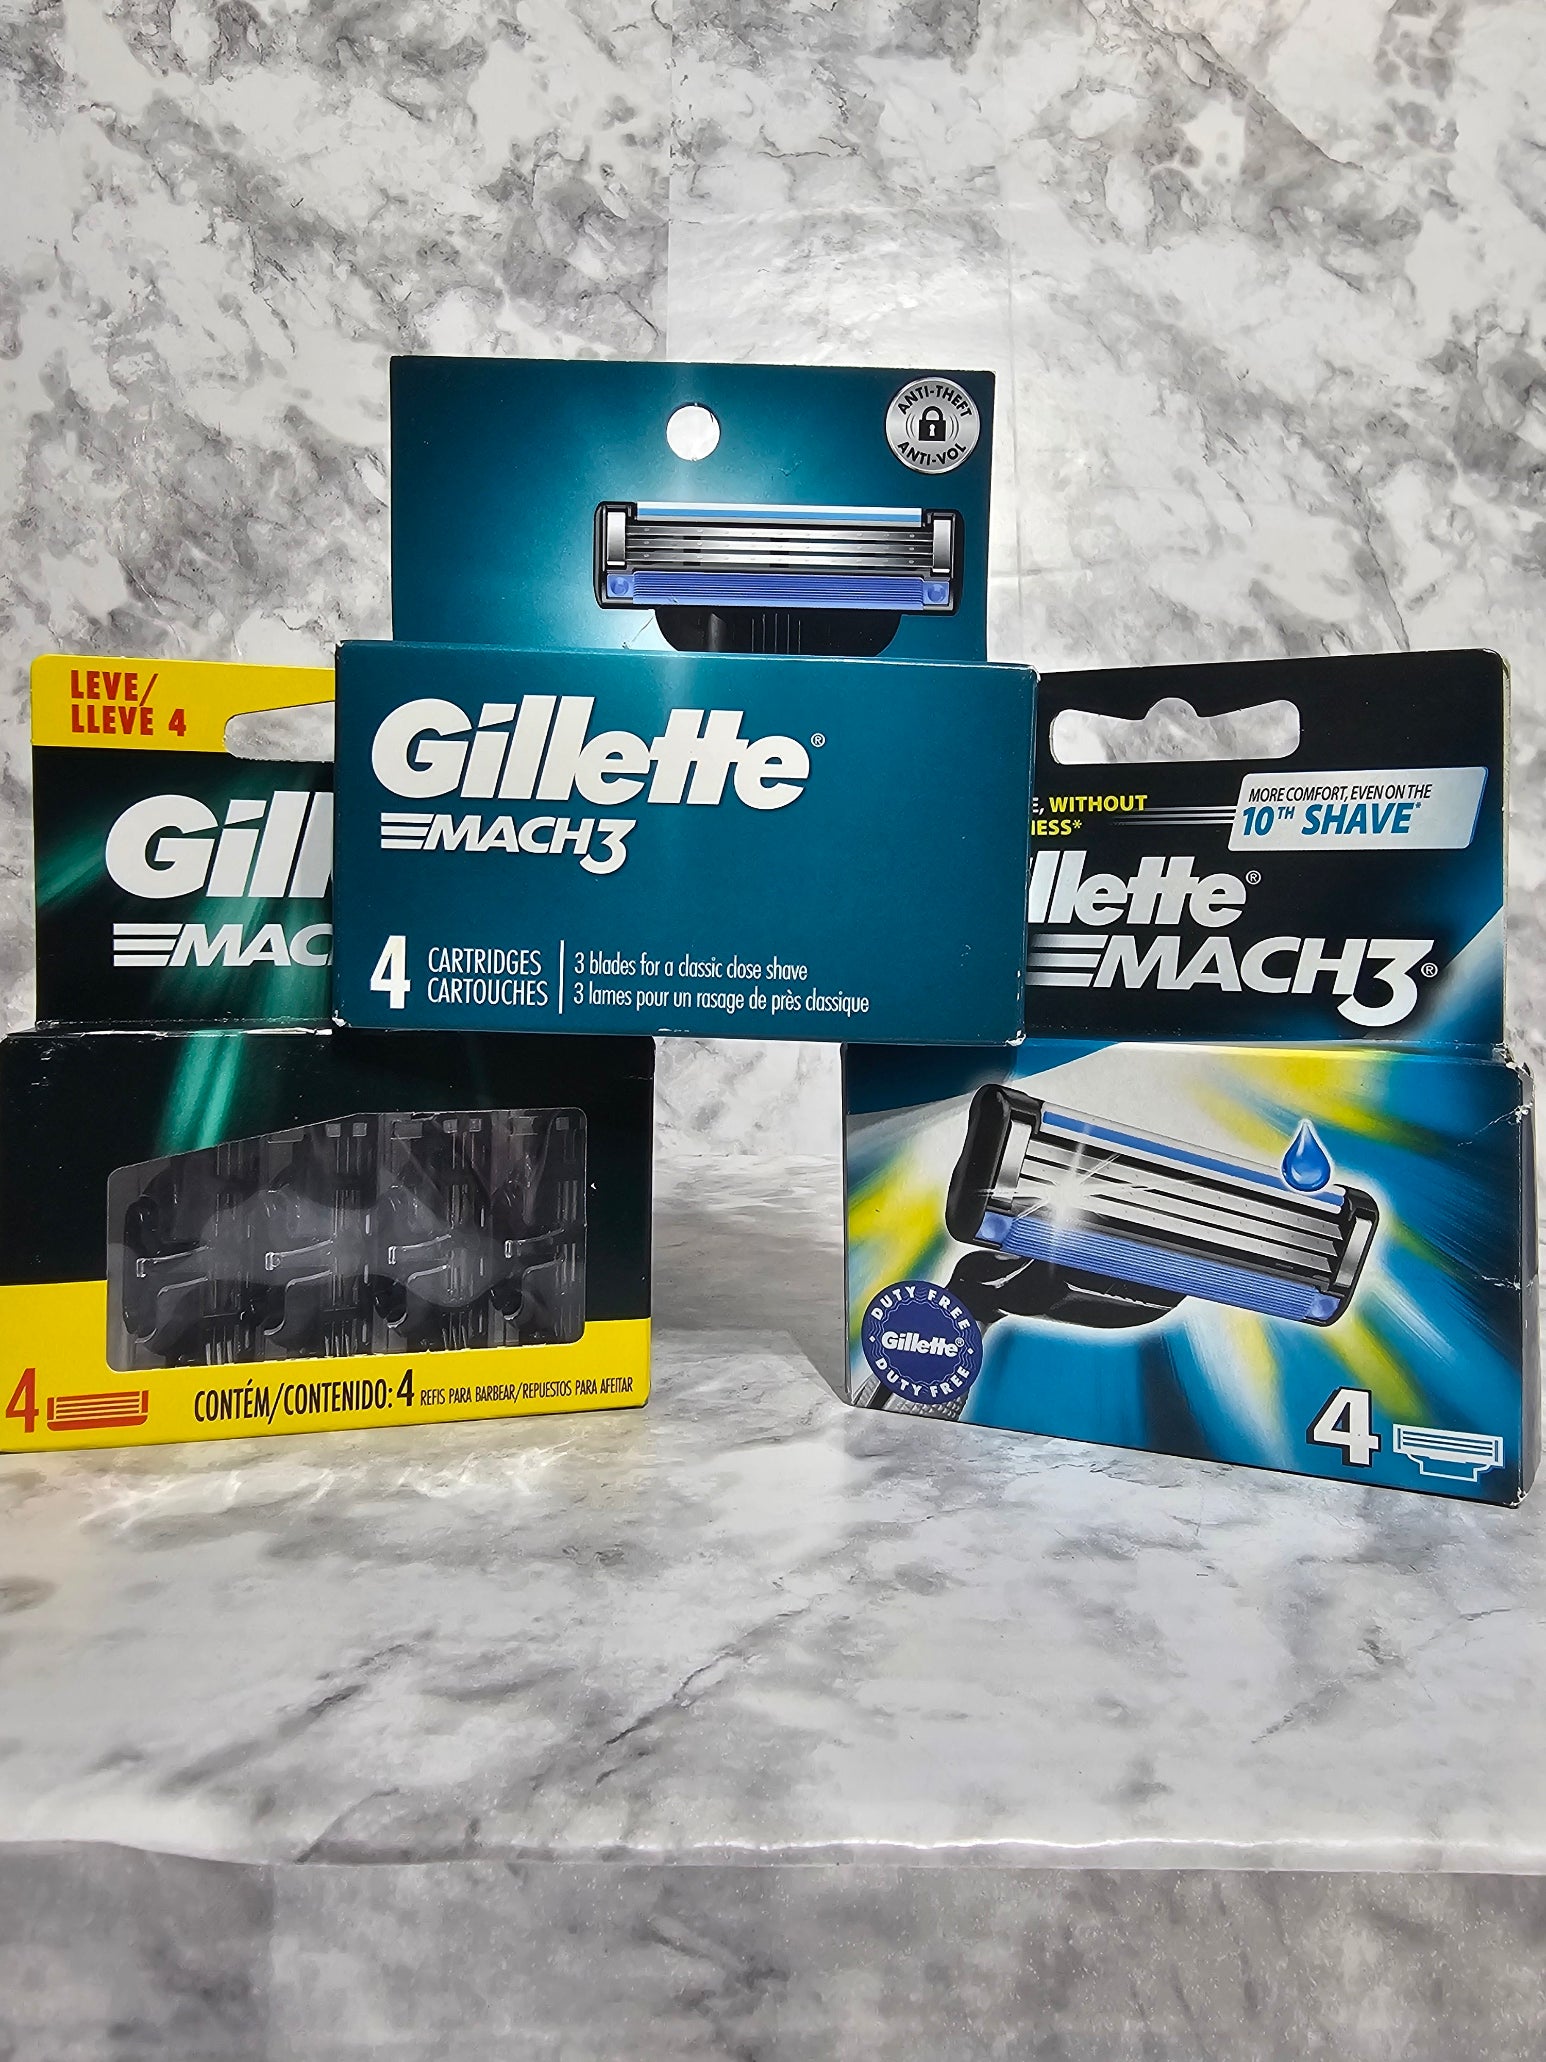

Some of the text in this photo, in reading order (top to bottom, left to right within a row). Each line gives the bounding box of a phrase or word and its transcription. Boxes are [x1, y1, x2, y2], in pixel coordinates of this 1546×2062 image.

[898, 385, 972, 417] ANTI-THEFT
[897, 441, 967, 466] ANTI-VOL
[71, 669, 158, 707] LEVE/
[71, 704, 187, 737] LLEVE 4
[1048, 794, 1148, 813] WITHOUT
[1248, 783, 1433, 803] MORE COMFORT, EVEN ON THE
[105, 790, 334, 899] Gill
[423, 814, 637, 875] MACH3
[168, 923, 334, 967] MAC
[428, 947, 543, 976] CARTRIDGES
[370, 935, 411, 1010] 4
[574, 951, 809, 981] 3 blades for a classic close shave
[427, 977, 549, 1007] CARTOUCHES
[573, 981, 870, 1018] 3 lames pour un rasage de près classique
[871, 1286, 971, 1331] DUTY FREE
[396, 1368, 415, 1407] 4
[420, 1376, 633, 1406] REFIS PARA BARBEAR/REPUESTOS PARA AFEITAR
[875, 1357, 970, 1398] DUTY FREE
[5, 1367, 39, 1433] 4
[1307, 1386, 1381, 1468] 4
